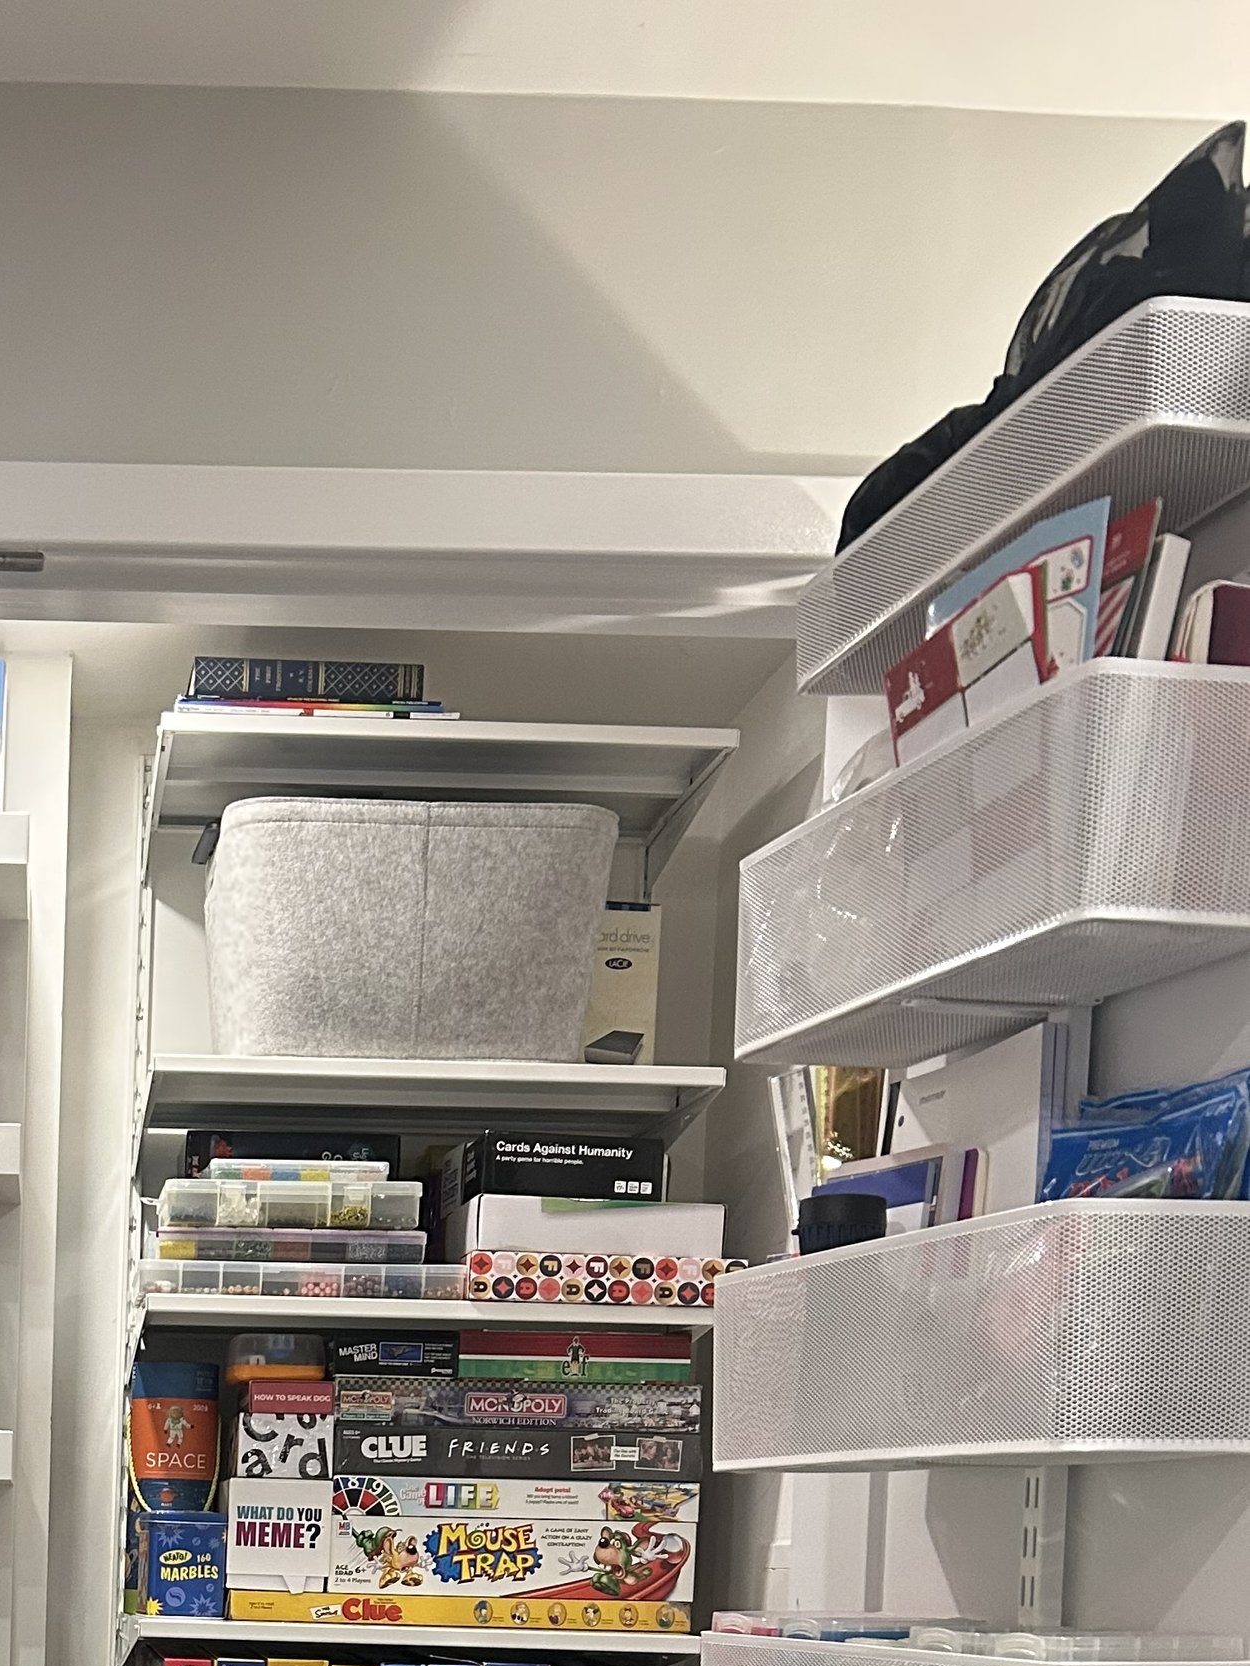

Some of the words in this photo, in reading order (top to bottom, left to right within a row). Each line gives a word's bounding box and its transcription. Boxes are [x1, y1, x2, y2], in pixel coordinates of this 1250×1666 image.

[600, 927, 619, 943] ard
[620, 929, 650, 943] drive
[496, 1140, 530, 1153] Cards
[533, 1142, 575, 1155] Against
[579, 1144, 633, 1159] Humanity
[339, 1343, 377, 1356] MASTER
[353, 1352, 378, 1362] MIND
[361, 1435, 428, 1459] CLUE
[146, 1453, 206, 1469] SPACE
[429, 1485, 493, 1505] LIFE
[237, 1506, 274, 1520] WHAT
[277, 1507, 294, 1521] DO
[297, 1507, 322, 1522] YOU
[235, 1521, 321, 1549] MEME?
[437, 1522, 537, 1557] MOUSE
[197, 1553, 211, 1563] 160
[161, 1565, 219, 1581] MARBLES
[342, 1598, 403, 1622] Clue
